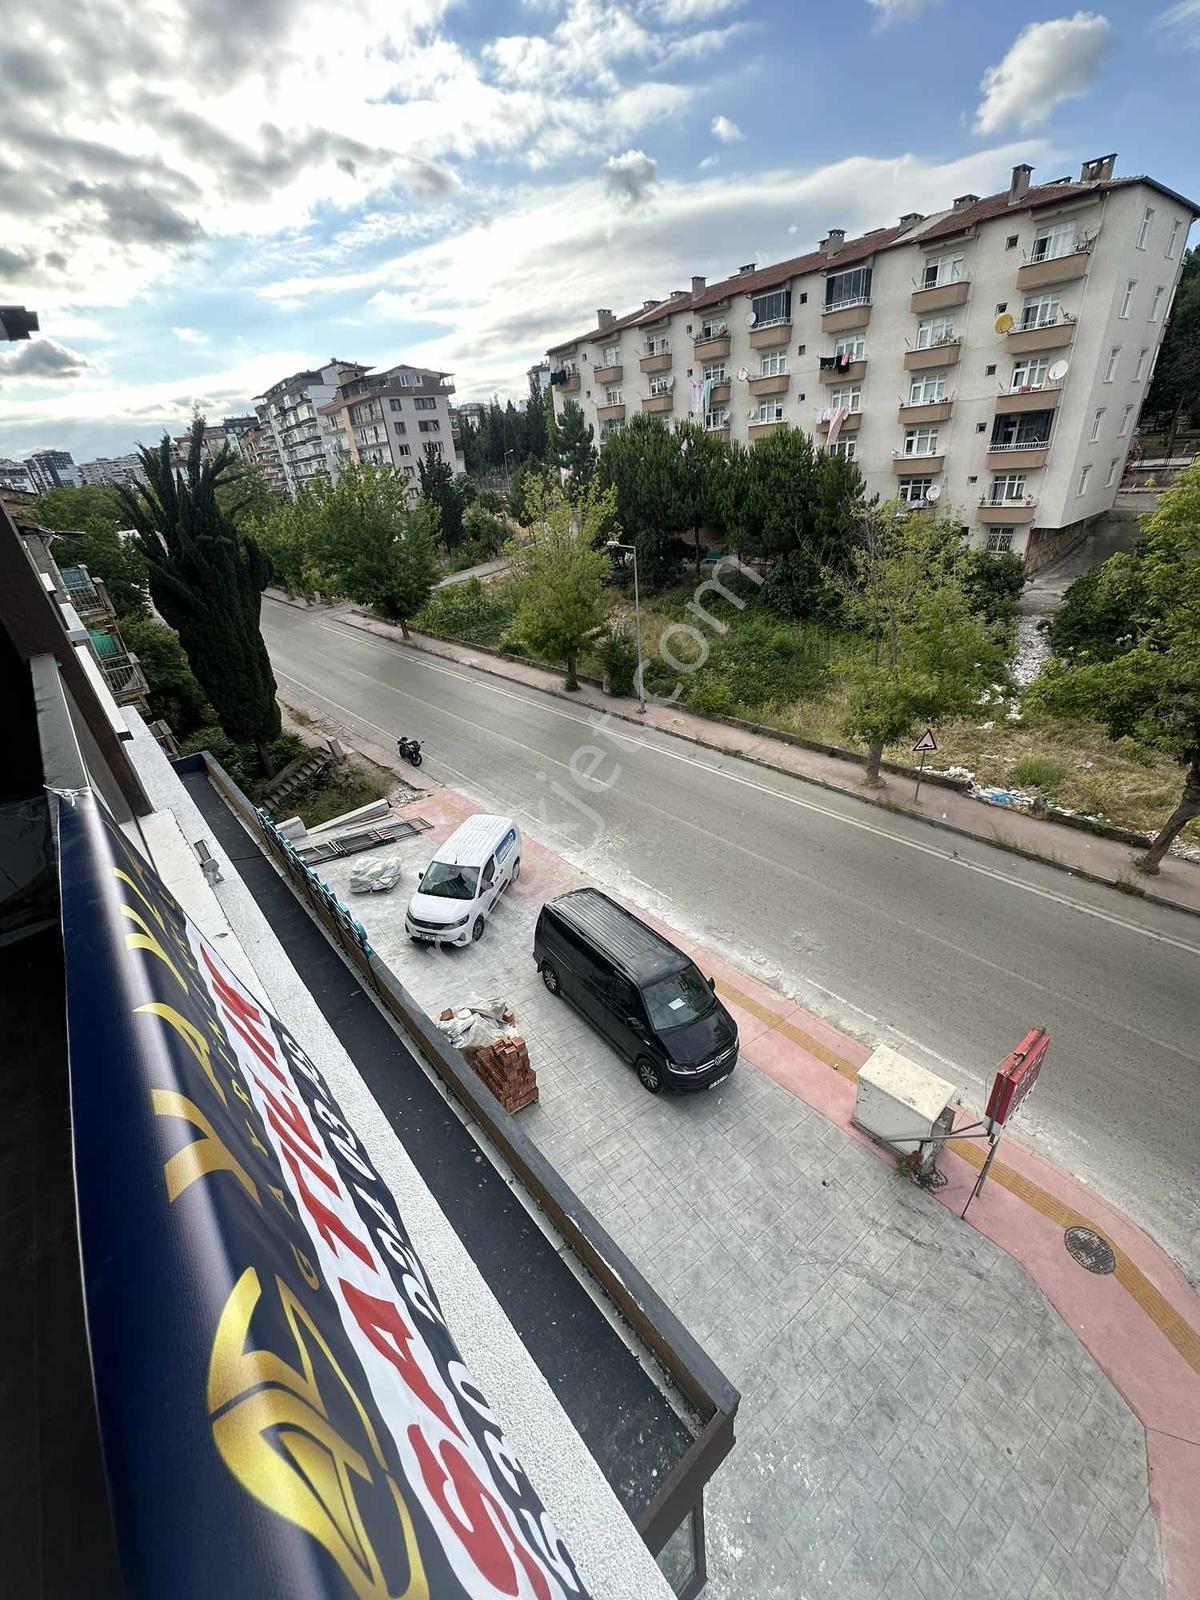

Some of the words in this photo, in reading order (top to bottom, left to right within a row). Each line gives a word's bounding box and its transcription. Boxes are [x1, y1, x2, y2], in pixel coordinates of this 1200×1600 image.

[314, 1099, 376, 1180] 03
[200, 942, 552, 1600] SATILIK
[353, 1182, 447, 1329] 224
